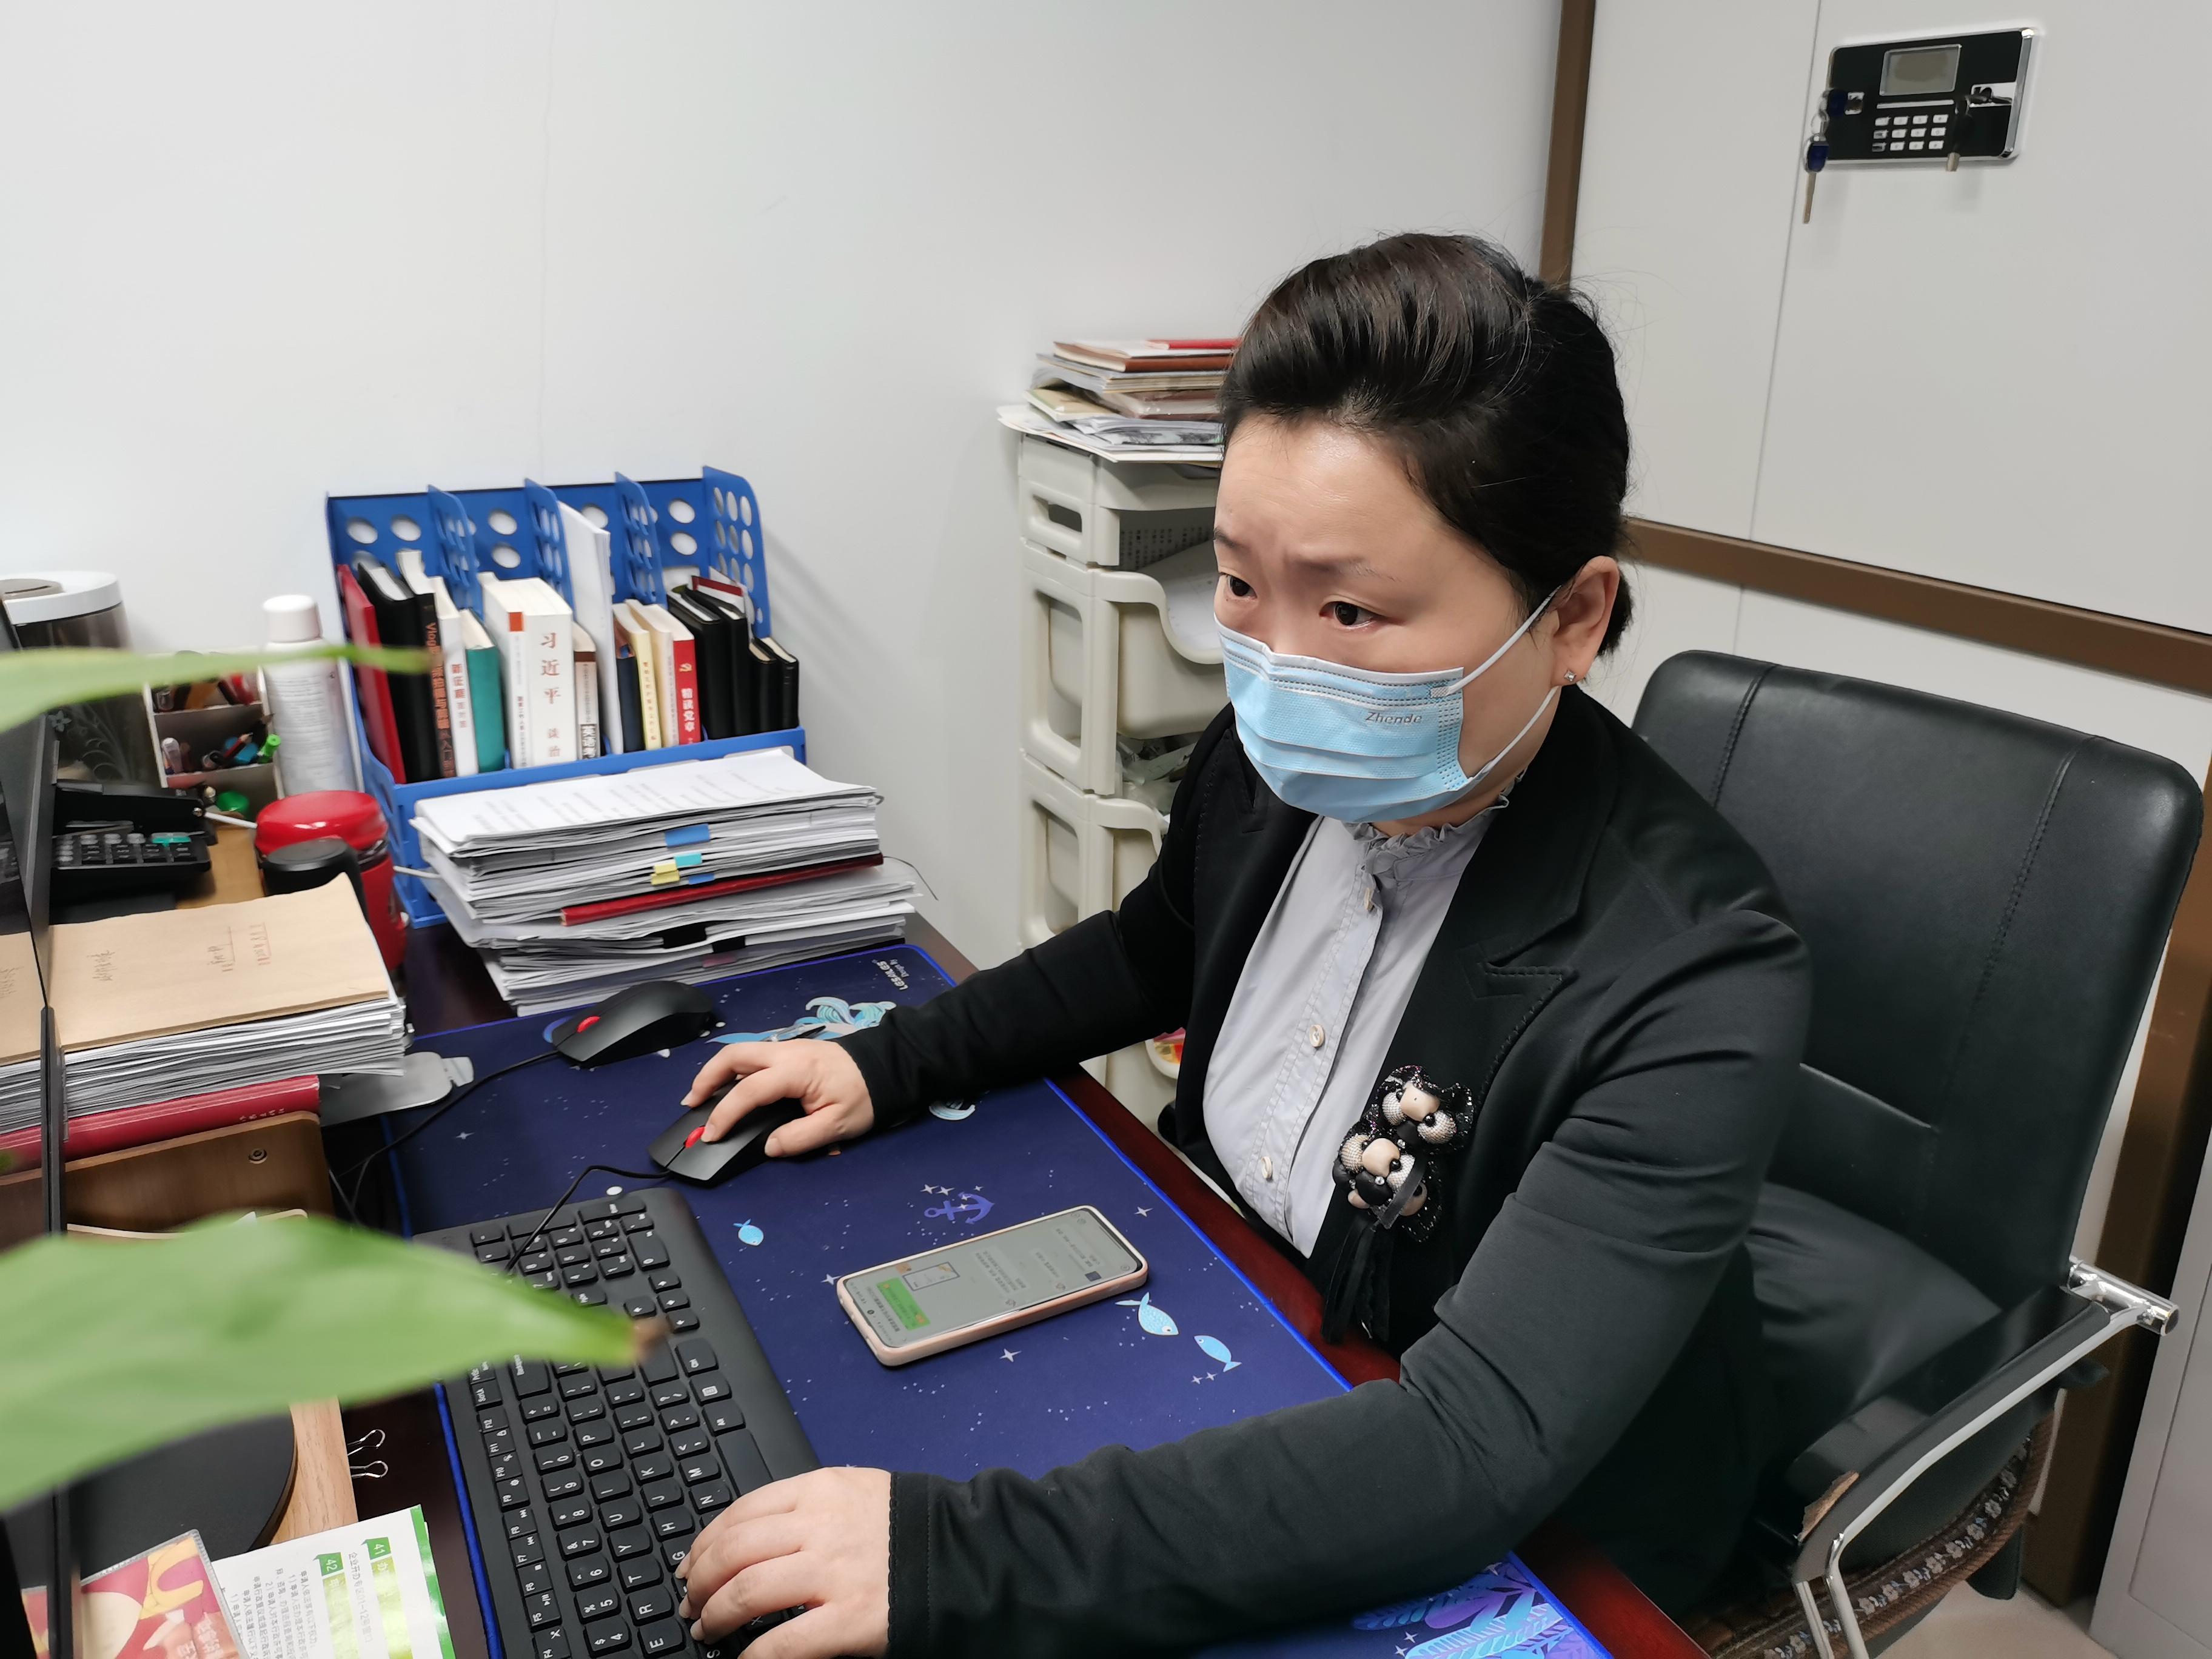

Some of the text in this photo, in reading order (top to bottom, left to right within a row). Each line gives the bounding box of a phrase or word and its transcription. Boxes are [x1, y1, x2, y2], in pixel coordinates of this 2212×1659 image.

[541, 632, 561, 705] 习近平
[1366, 712, 1423, 723] Zhende
[484, 1419, 492, 1429] F12
[490, 1444, 499, 1452] F11
[496, 1467, 504, 1477] F10
[641, 1467, 654, 1476] K
[688, 1468, 702, 1477] M
[700, 1495, 714, 1504] N
[662, 1523, 675, 1531] H
[374, 1544, 385, 1555] 41
[672, 1551, 685, 1560] G
[326, 1559, 337, 1572] 42
[639, 1604, 653, 1614] R
[751, 1615, 763, 1625] X
[649, 1638, 663, 1648] E
[543, 1649, 553, 1659] F4
